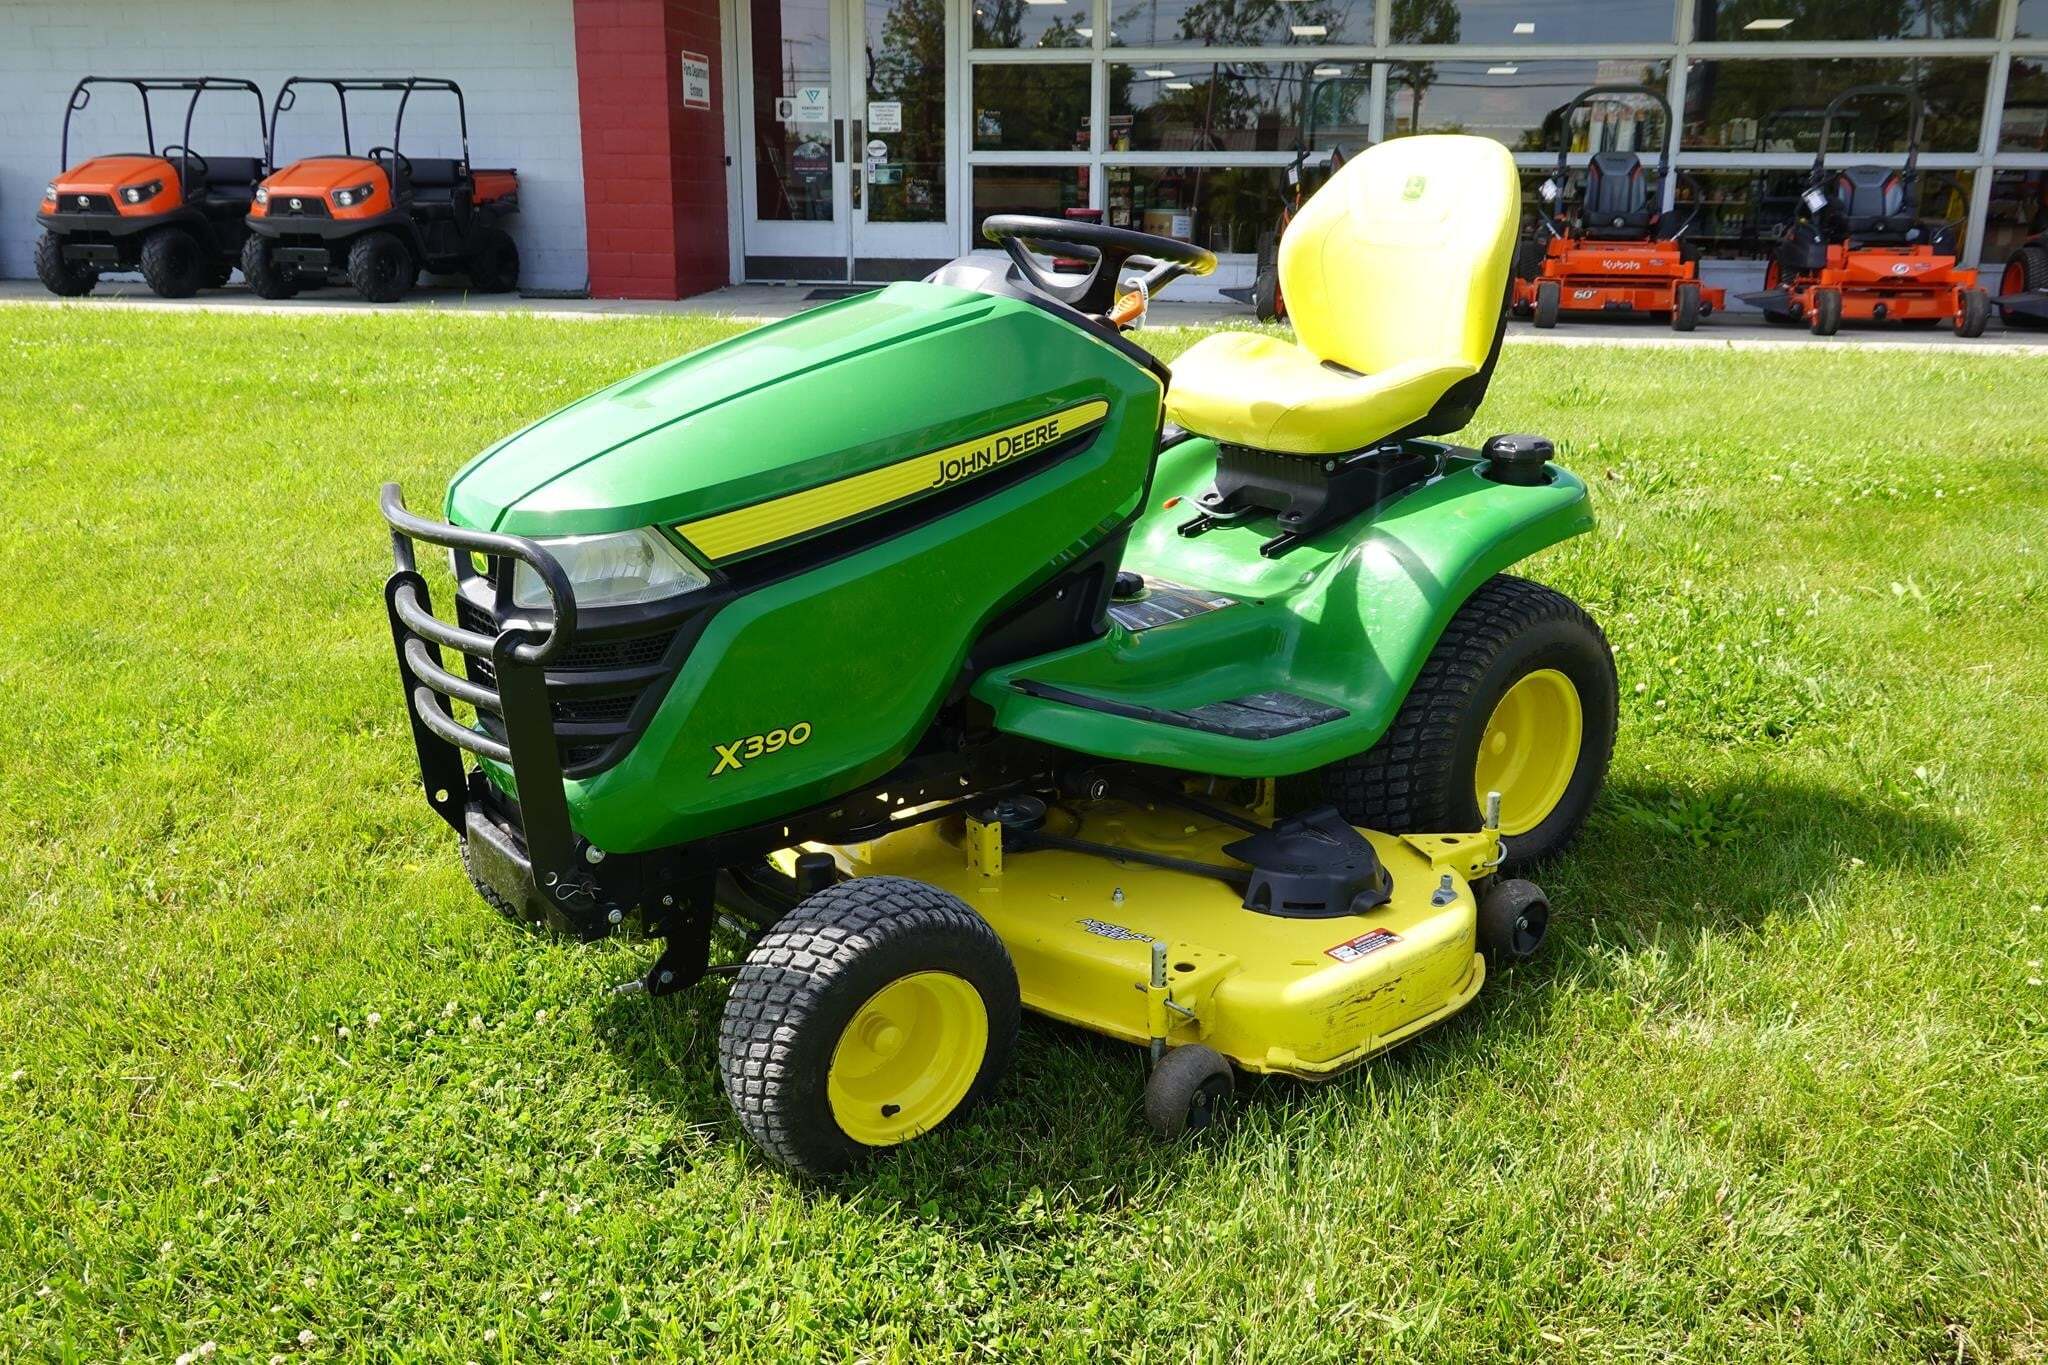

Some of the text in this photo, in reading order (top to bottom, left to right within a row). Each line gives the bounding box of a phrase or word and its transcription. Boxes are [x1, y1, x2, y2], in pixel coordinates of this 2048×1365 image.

[1602, 259, 1641, 270] Kubota
[932, 419, 1060, 487] JOHN DEERE
[710, 721, 812, 777] X390
[1077, 917, 1131, 935] ACCEL
[1086, 926, 1133, 941] DEEP
